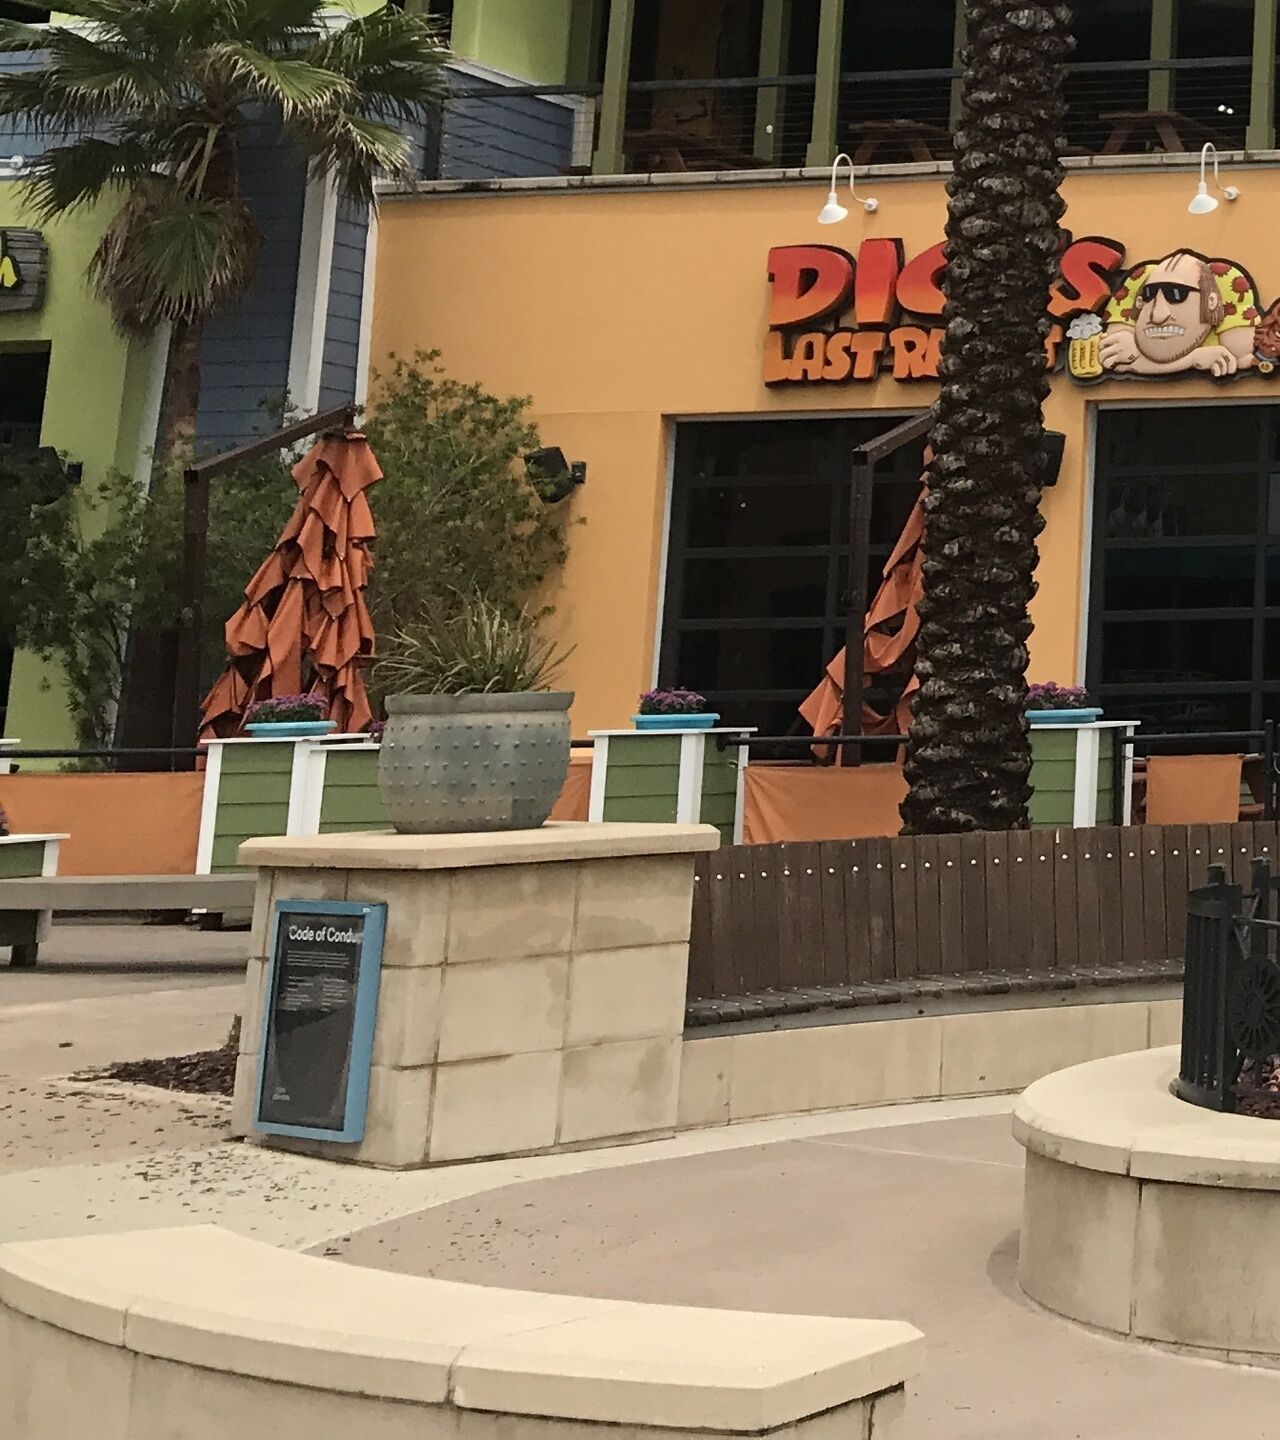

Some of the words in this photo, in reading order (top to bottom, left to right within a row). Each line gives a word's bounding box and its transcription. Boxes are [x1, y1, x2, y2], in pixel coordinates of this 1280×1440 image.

[764, 330, 887, 388] LAST
[288, 925, 314, 941] Code
[315, 926, 327, 942] of
